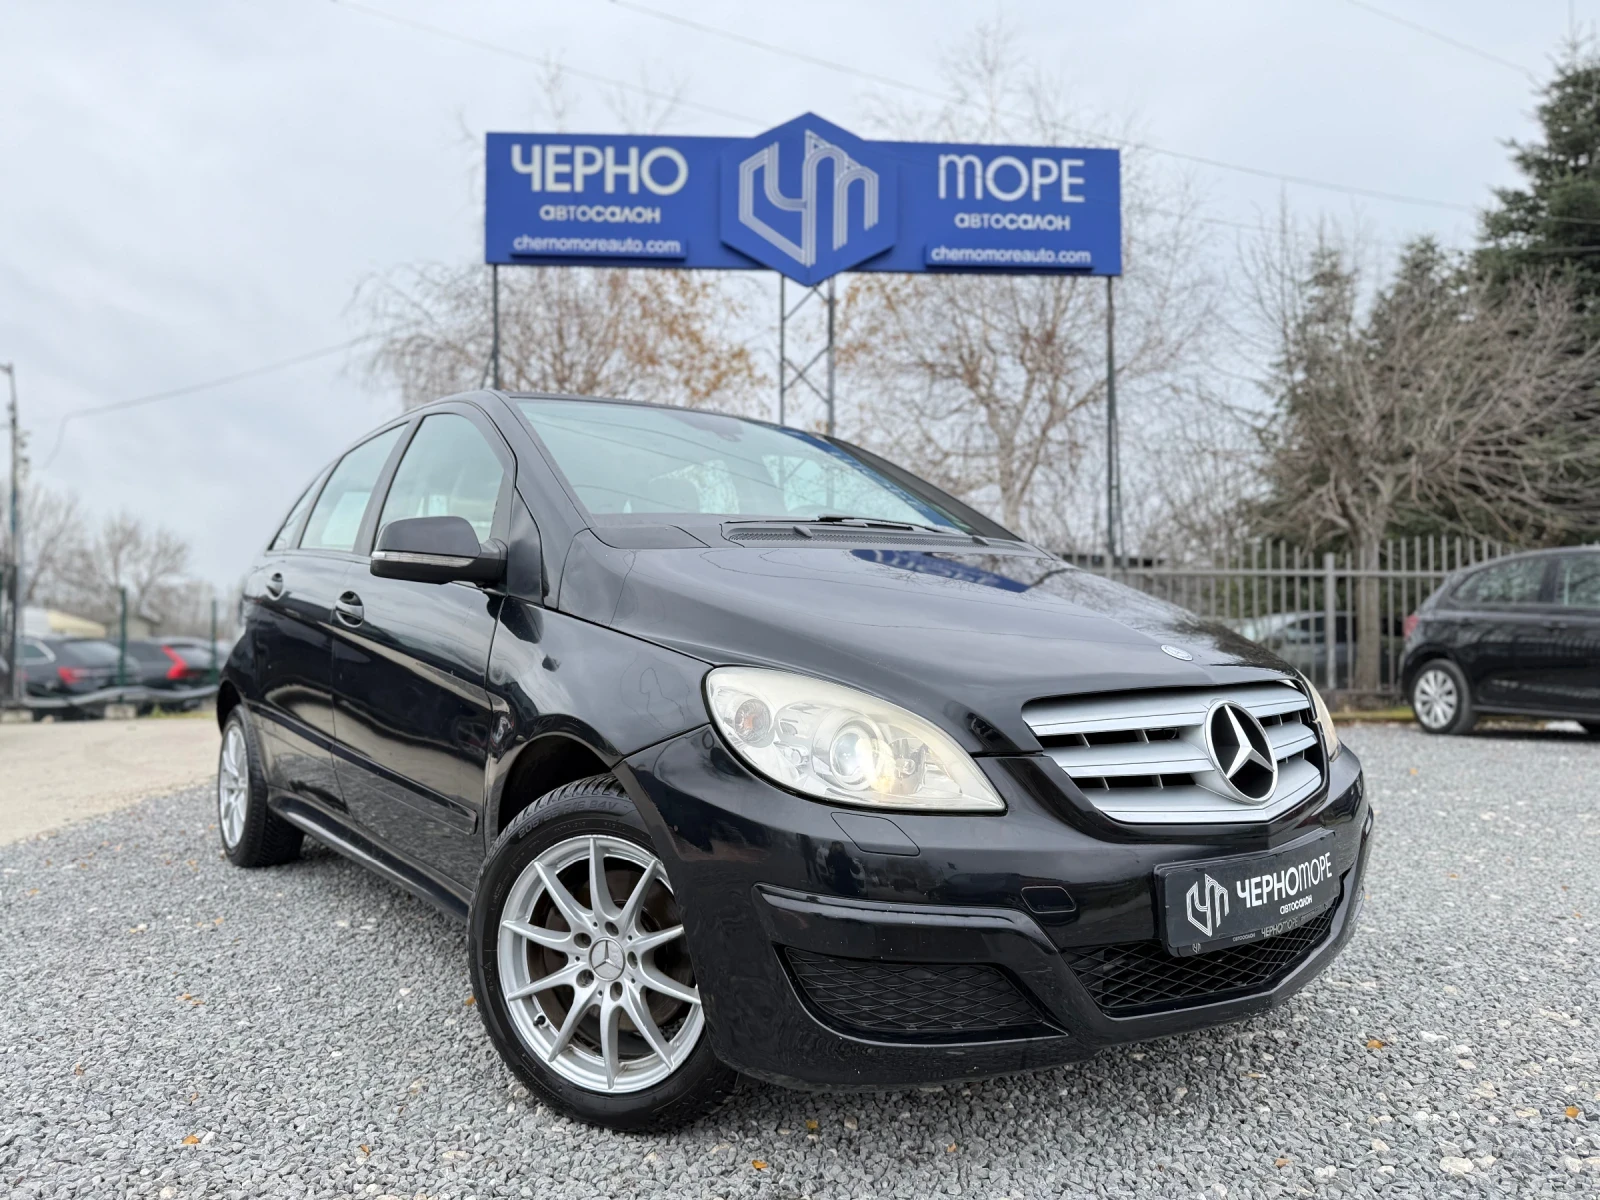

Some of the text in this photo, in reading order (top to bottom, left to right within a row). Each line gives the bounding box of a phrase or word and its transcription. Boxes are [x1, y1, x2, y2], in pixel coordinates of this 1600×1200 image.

[510, 144, 688, 196] ЧЕРНО
[539, 204, 661, 224] автосалон
[954, 212, 1071, 231] автосалон
[513, 234, 681, 253] chernomoreauto.com
[931, 245, 1091, 263] chernomoreauto.com
